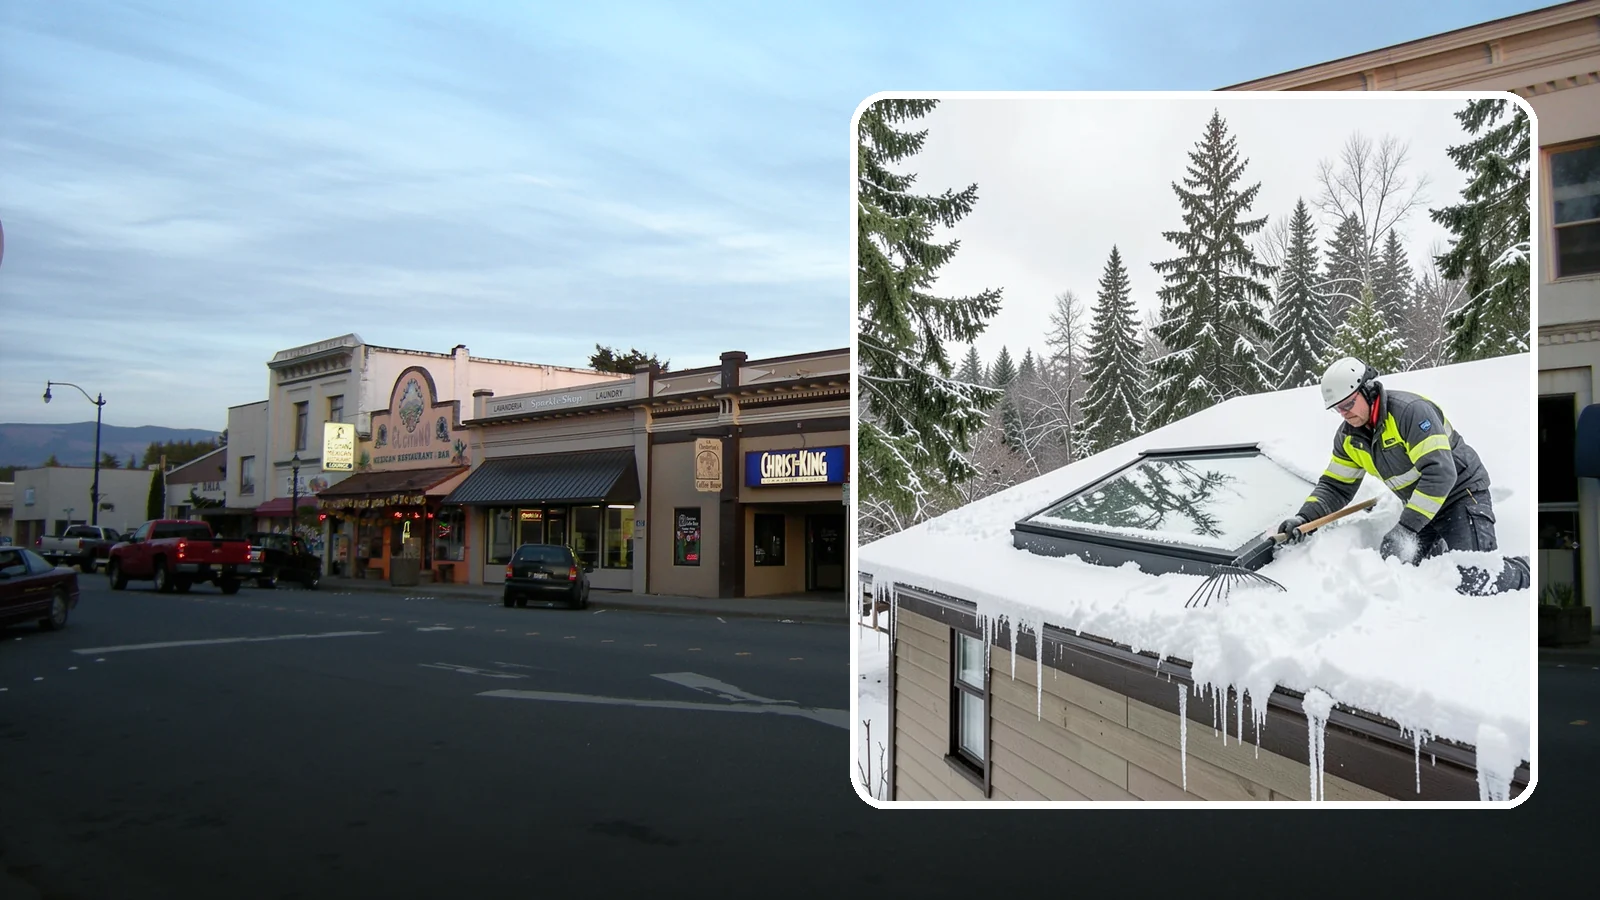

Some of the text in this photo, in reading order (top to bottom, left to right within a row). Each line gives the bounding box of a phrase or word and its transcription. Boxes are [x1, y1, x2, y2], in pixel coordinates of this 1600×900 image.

[595, 389, 624, 399] LAUNDRY
[494, 402, 523, 412] LAVANDERIA
[530, 395, 583, 408] Sparkle Shop
[373, 455, 396, 464] MEXICAN
[397, 452, 433, 462] RESTAURANT
[438, 450, 450, 459] BAR
[761, 450, 827, 478] CHRIST KING
